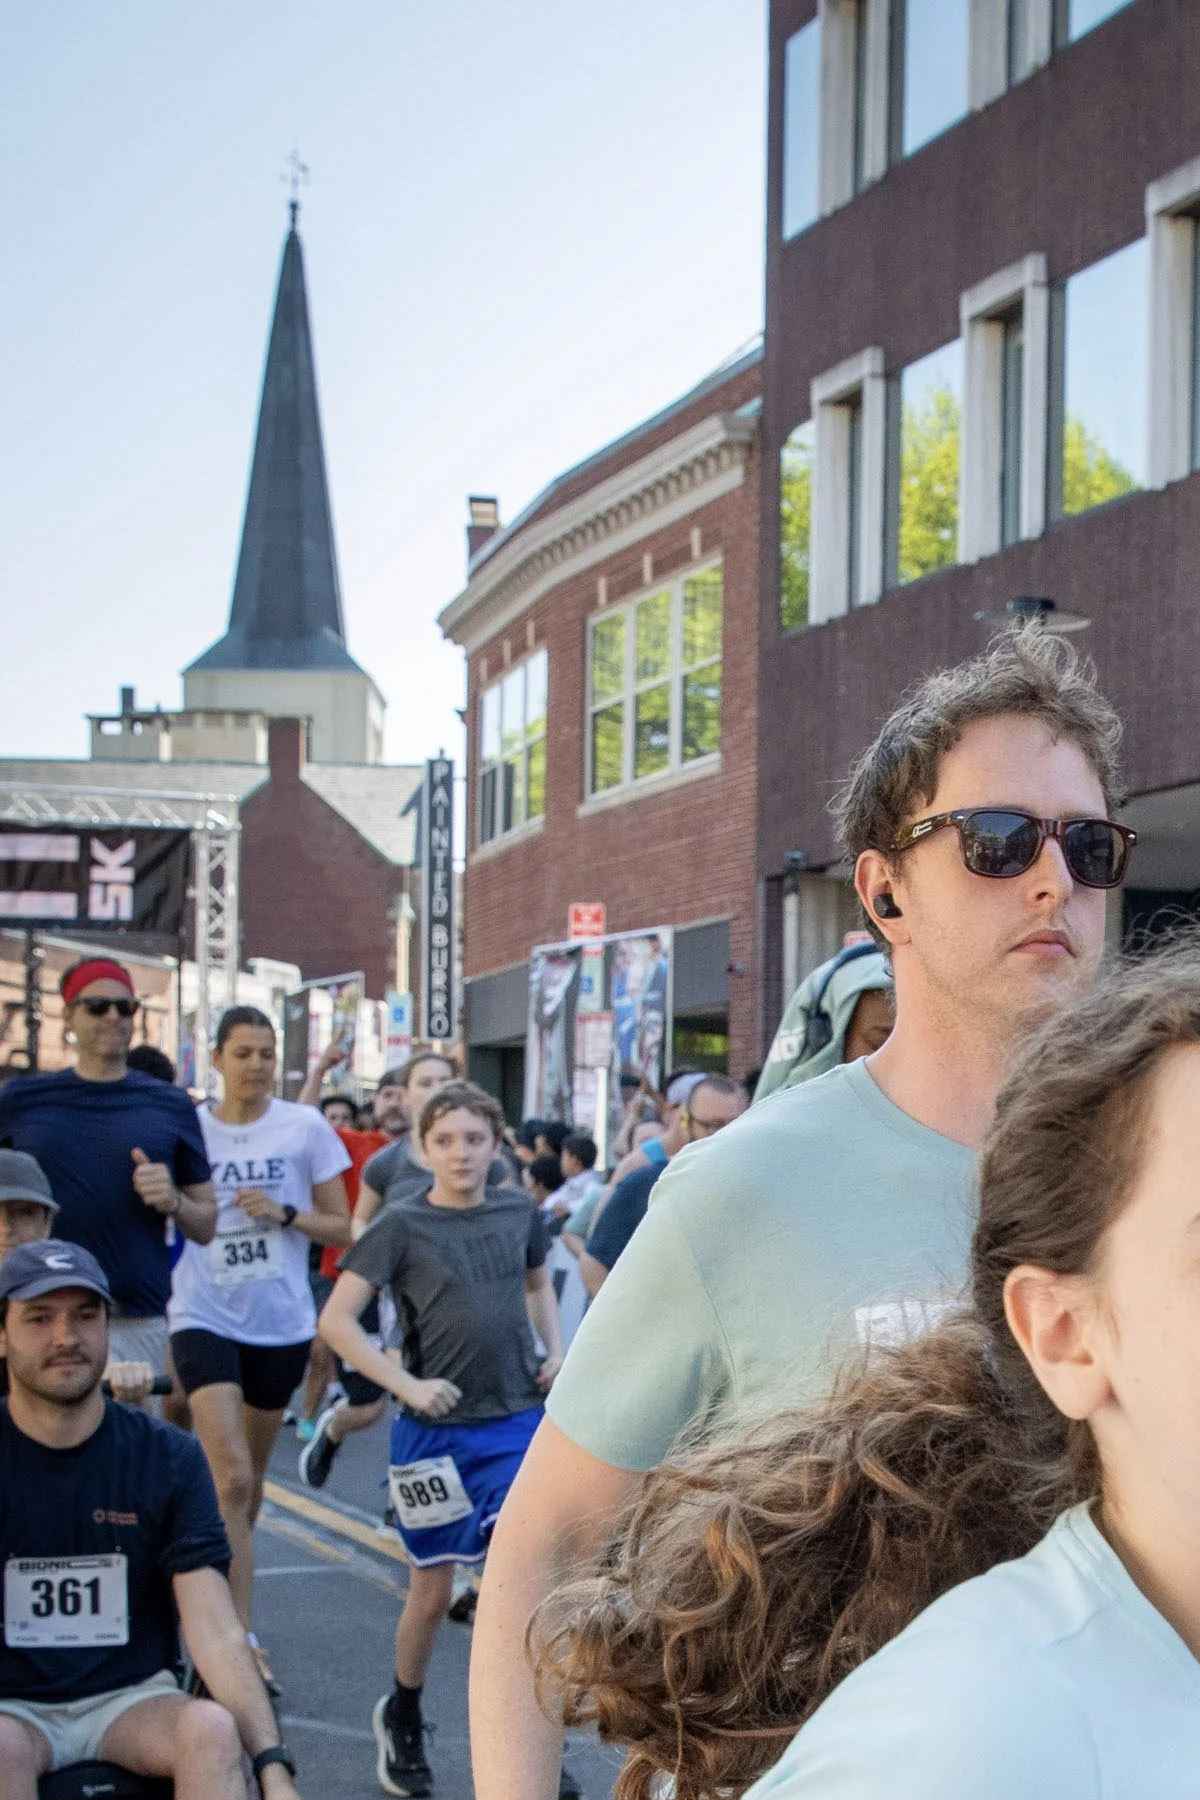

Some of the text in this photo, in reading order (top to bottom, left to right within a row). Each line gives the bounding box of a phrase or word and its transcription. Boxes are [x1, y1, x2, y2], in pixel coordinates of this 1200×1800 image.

[88, 836, 136, 921] 5K
[430, 762, 450, 1036] PAINTED BURRO
[224, 1238, 268, 1266] 334
[398, 1475, 449, 1508] 989
[31, 1577, 101, 1618] 361
